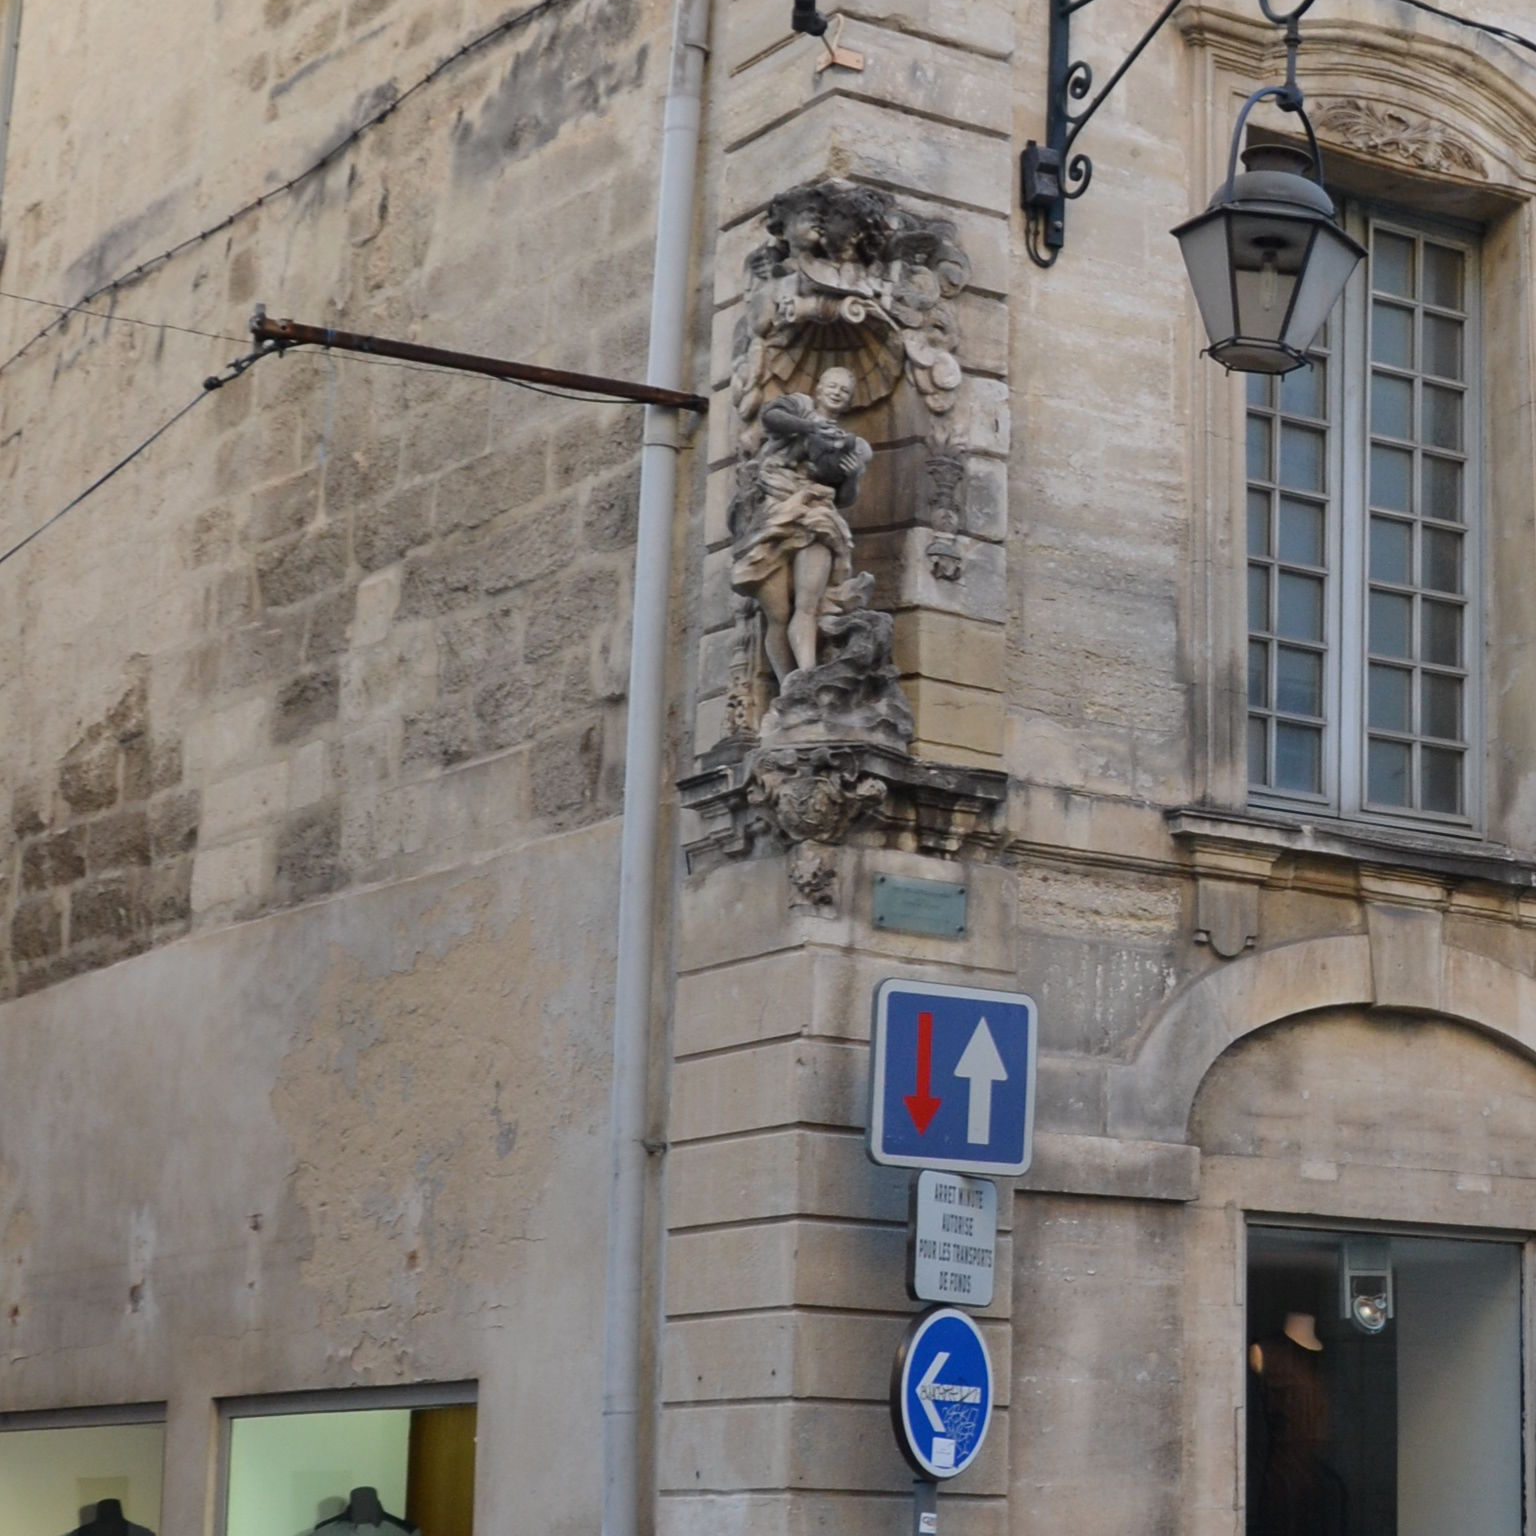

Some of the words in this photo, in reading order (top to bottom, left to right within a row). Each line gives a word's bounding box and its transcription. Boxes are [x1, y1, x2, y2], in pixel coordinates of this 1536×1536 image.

[918, 1238, 937, 1260] POUR
[938, 1241, 951, 1262] LES
[952, 1244, 993, 1269] TRANSPORTS
[938, 1270, 948, 1291] DE
[949, 1272, 972, 1294] FONDS
